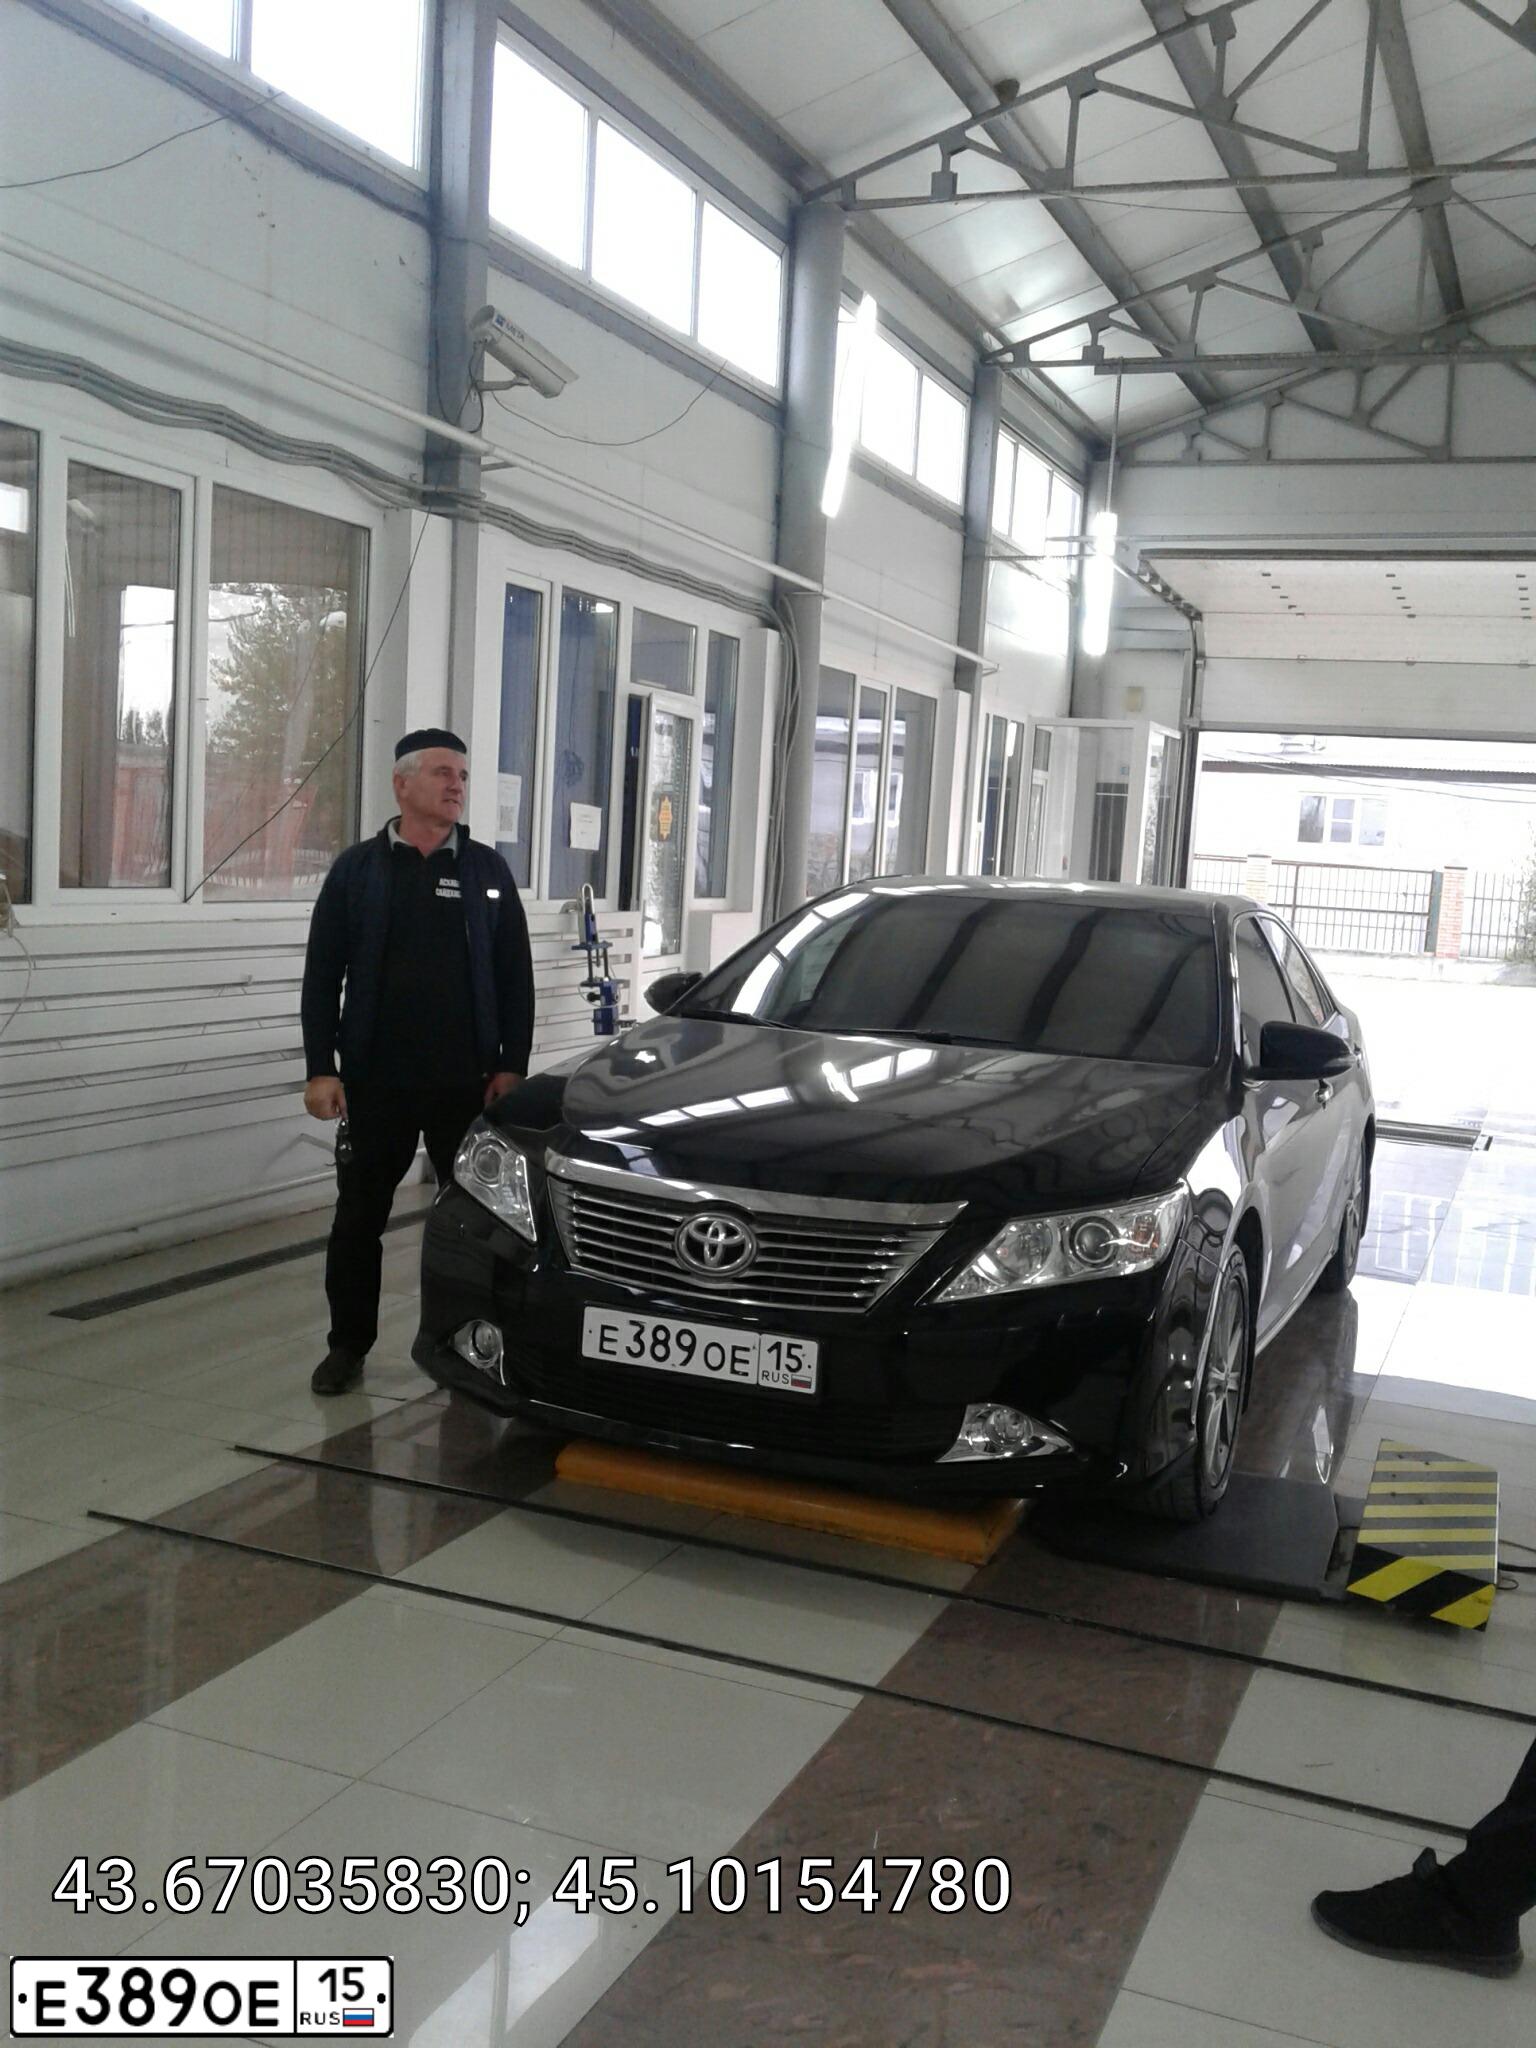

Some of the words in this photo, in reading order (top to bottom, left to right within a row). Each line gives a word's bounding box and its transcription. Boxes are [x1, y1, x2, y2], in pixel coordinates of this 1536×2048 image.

[599, 1319, 749, 1377] E389OE
[767, 1341, 803, 1373] 15
[761, 1370, 790, 1385] RUS
